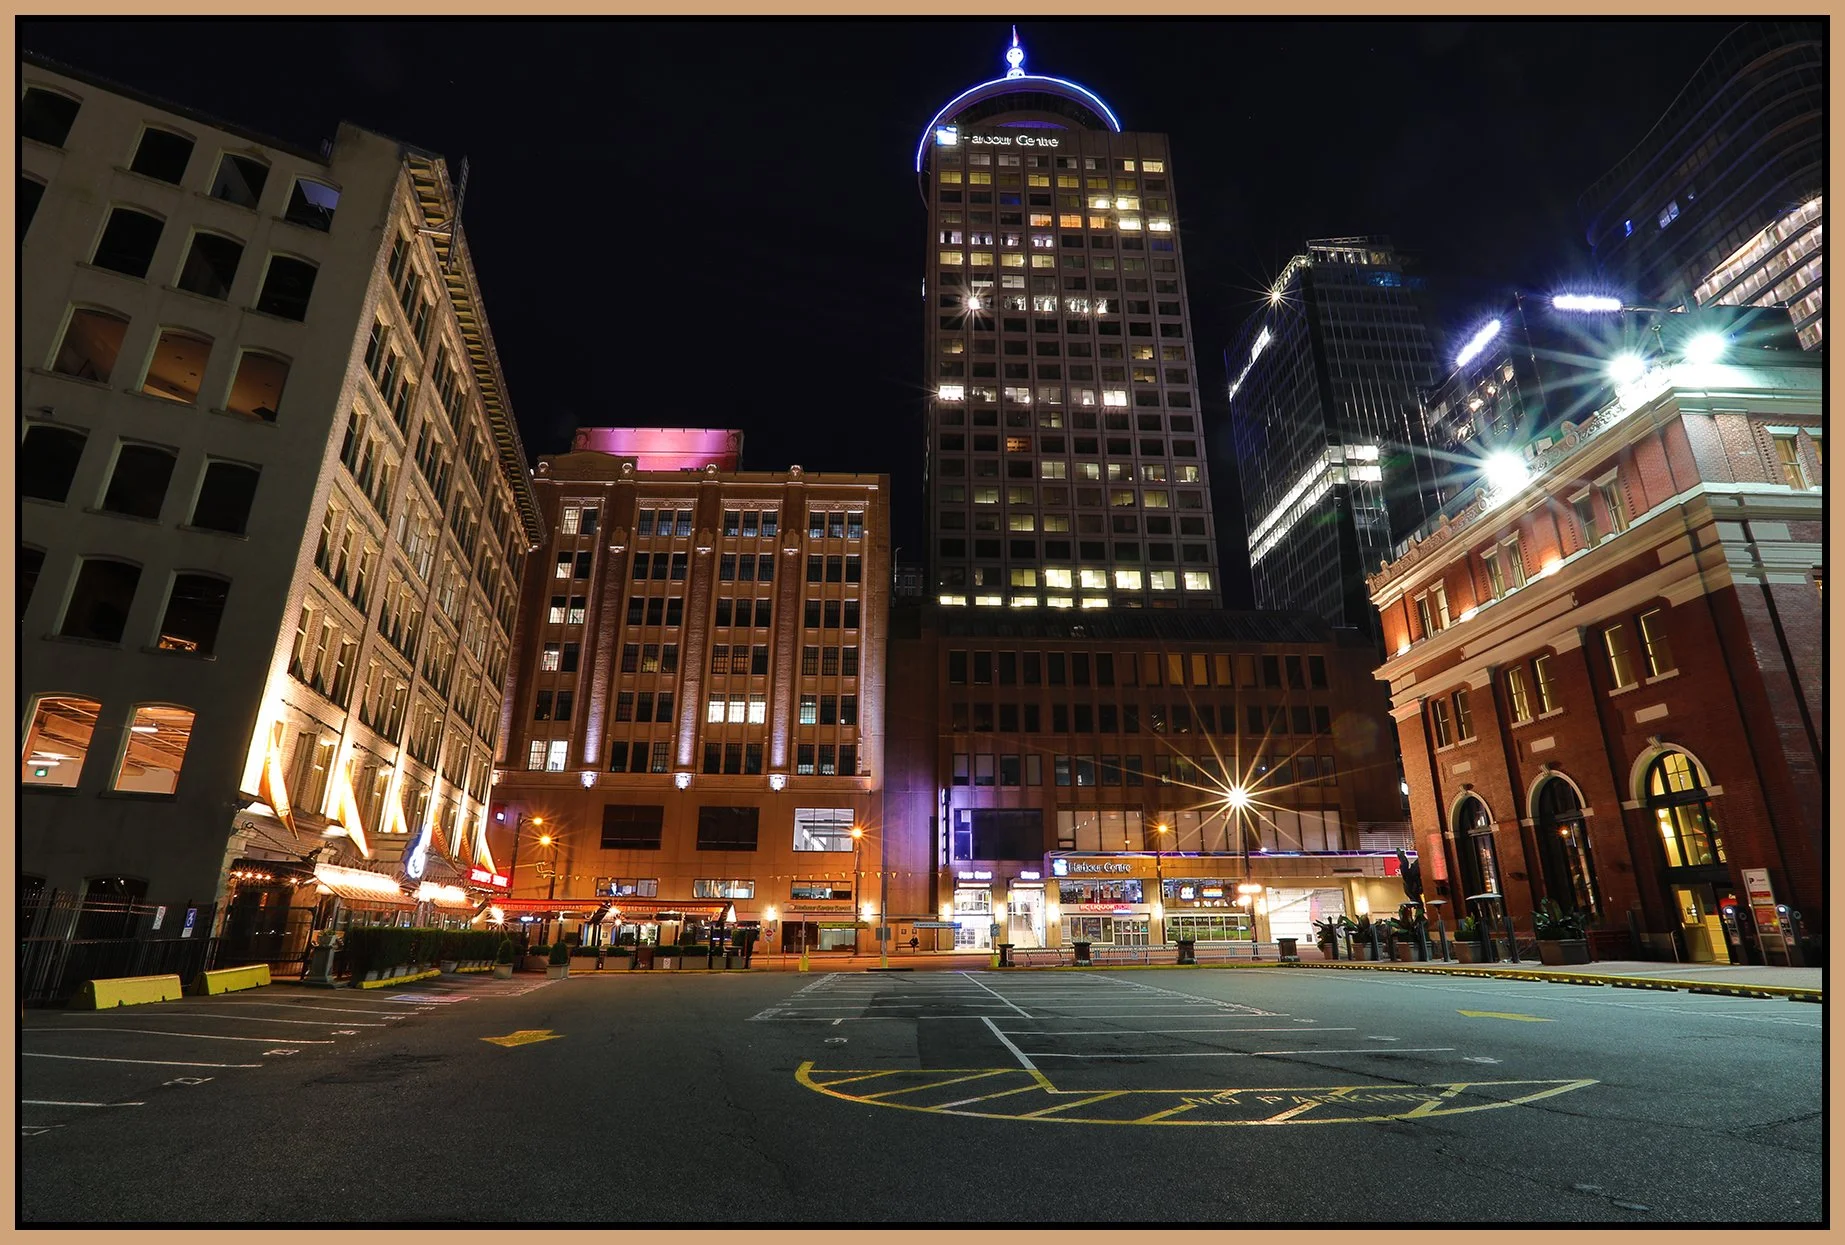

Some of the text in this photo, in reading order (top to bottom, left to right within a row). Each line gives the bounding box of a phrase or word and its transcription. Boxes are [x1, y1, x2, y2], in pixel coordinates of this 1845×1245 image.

[963, 134, 1060, 147] arbour Centre
[1068, 861, 1132, 873] Harbour Centre
[1090, 903, 1115, 911] LIQUOR
[1180, 1093, 1441, 1105] NO PARKING
